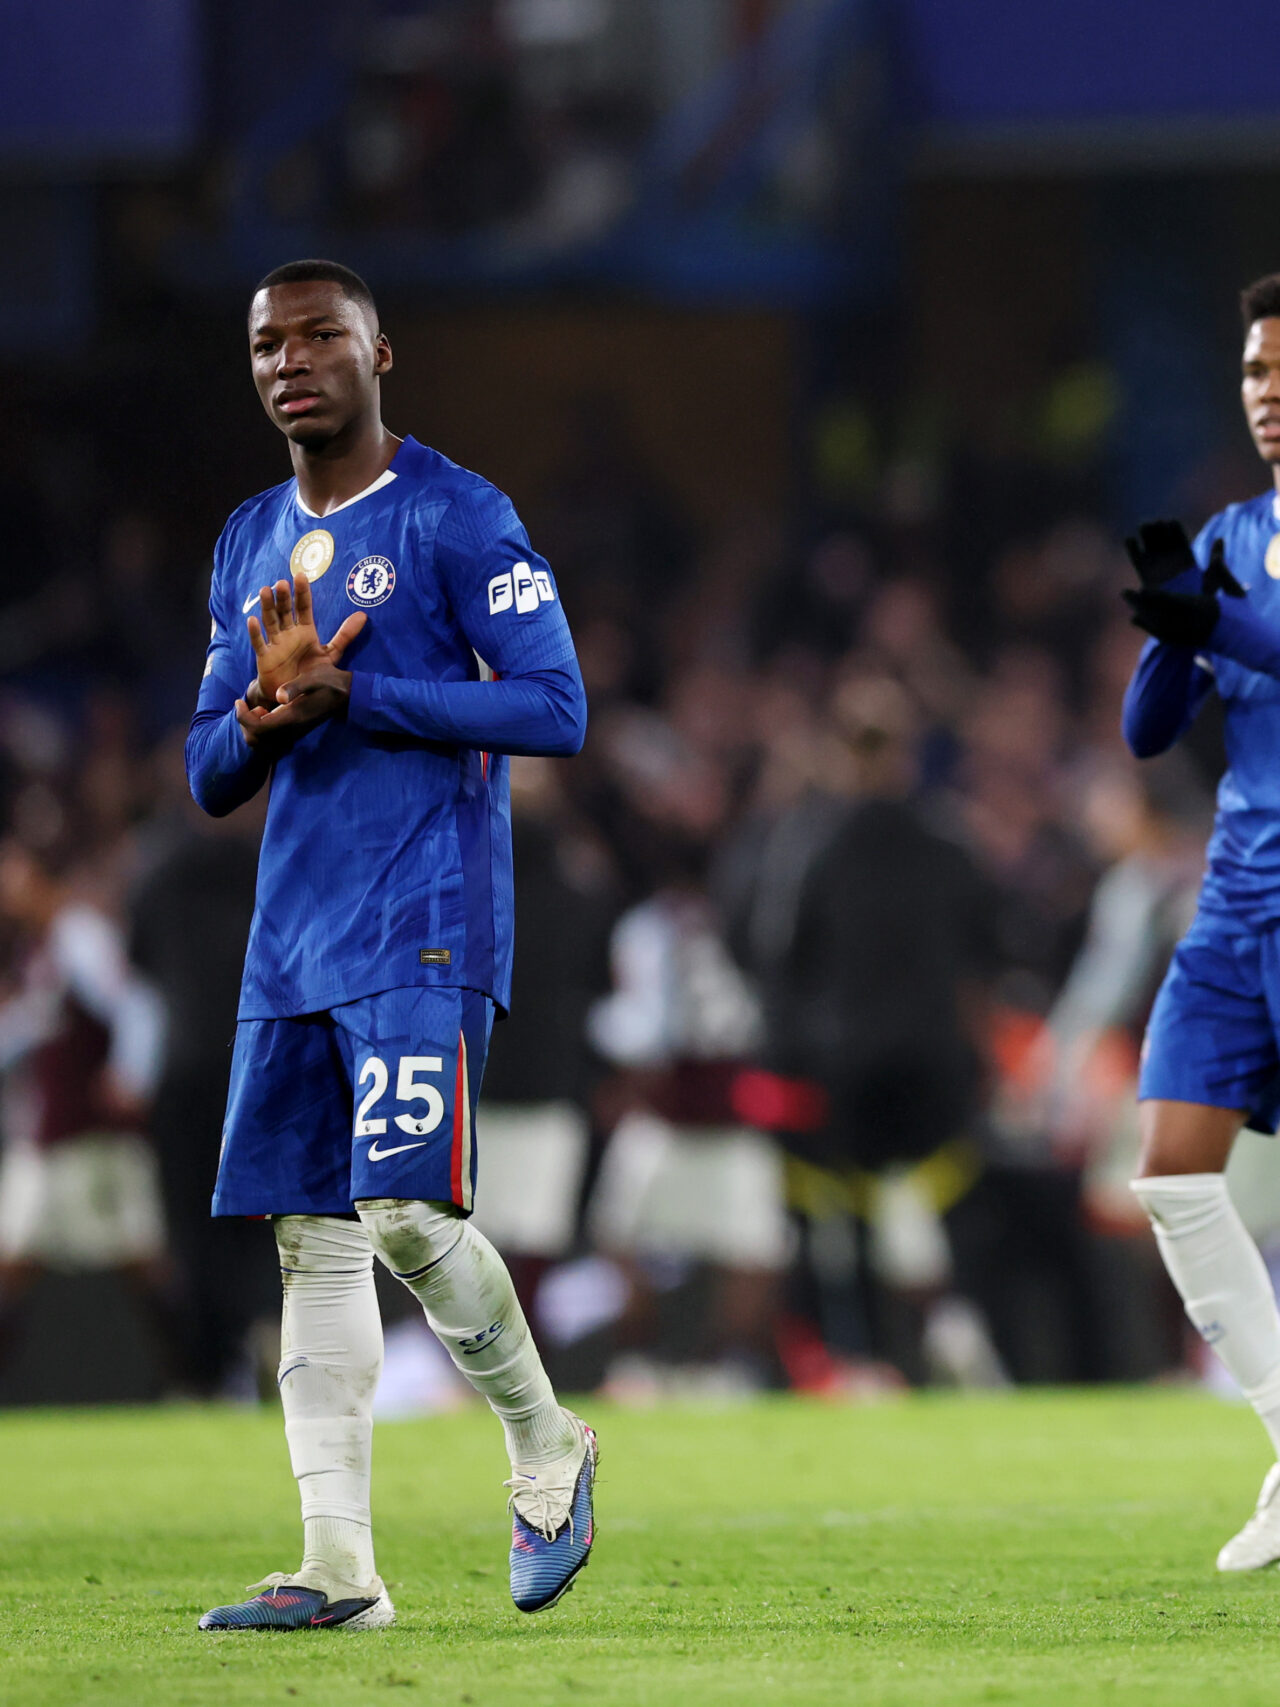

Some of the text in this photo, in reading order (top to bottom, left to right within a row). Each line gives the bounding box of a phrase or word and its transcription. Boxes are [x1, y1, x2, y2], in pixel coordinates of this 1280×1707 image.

[358, 556, 389, 569] CHELSEA
[354, 1056, 445, 1138] 25
[458, 1320, 504, 1347] CFC
